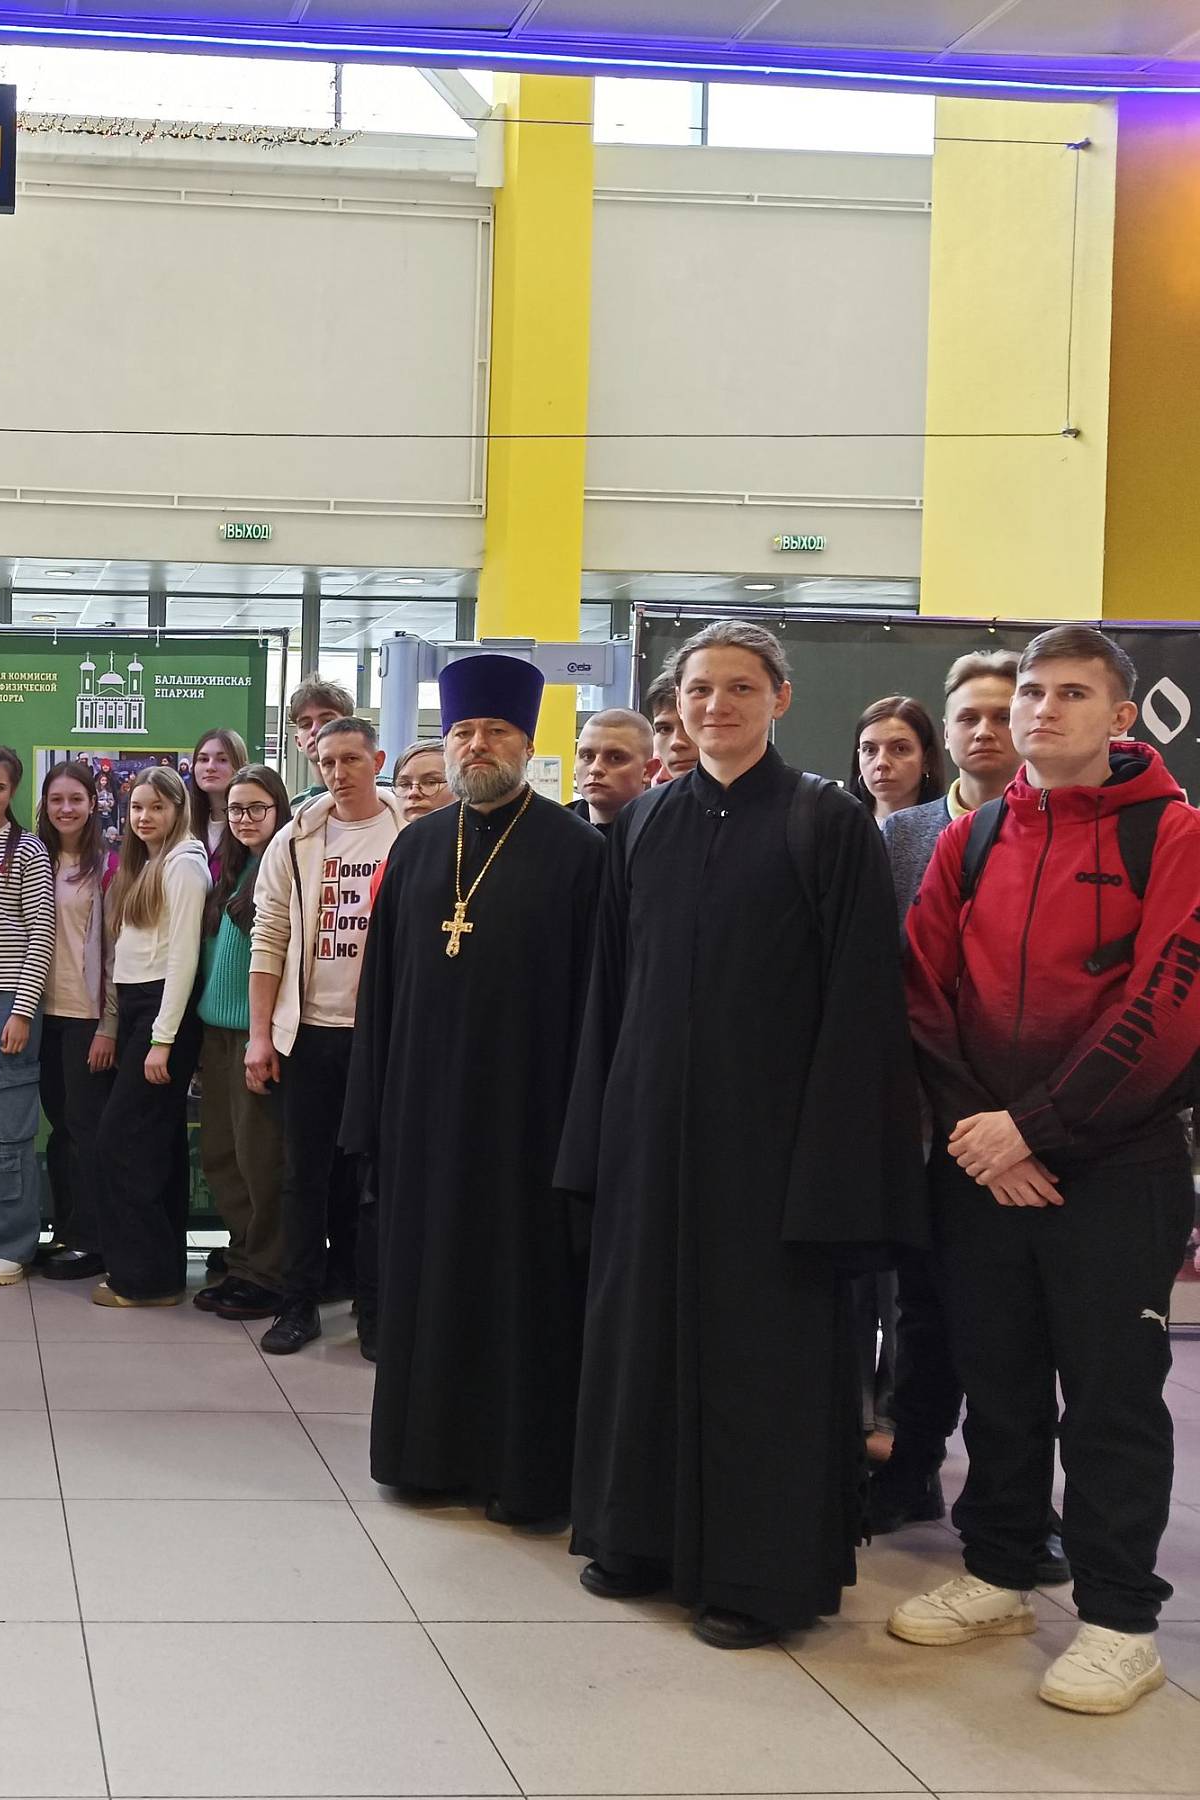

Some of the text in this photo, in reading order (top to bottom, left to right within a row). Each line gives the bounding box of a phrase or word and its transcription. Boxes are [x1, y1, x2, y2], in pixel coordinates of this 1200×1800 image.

[227, 523, 269, 539] ВЫХОД
[782, 535, 824, 550] ВЫХОД
[8, 672, 58, 681] КОММИСИЯ
[154, 674, 252, 686] БАЛАШИХИНСКАЯ
[154, 688, 205, 699] ЕПАРХИЯ
